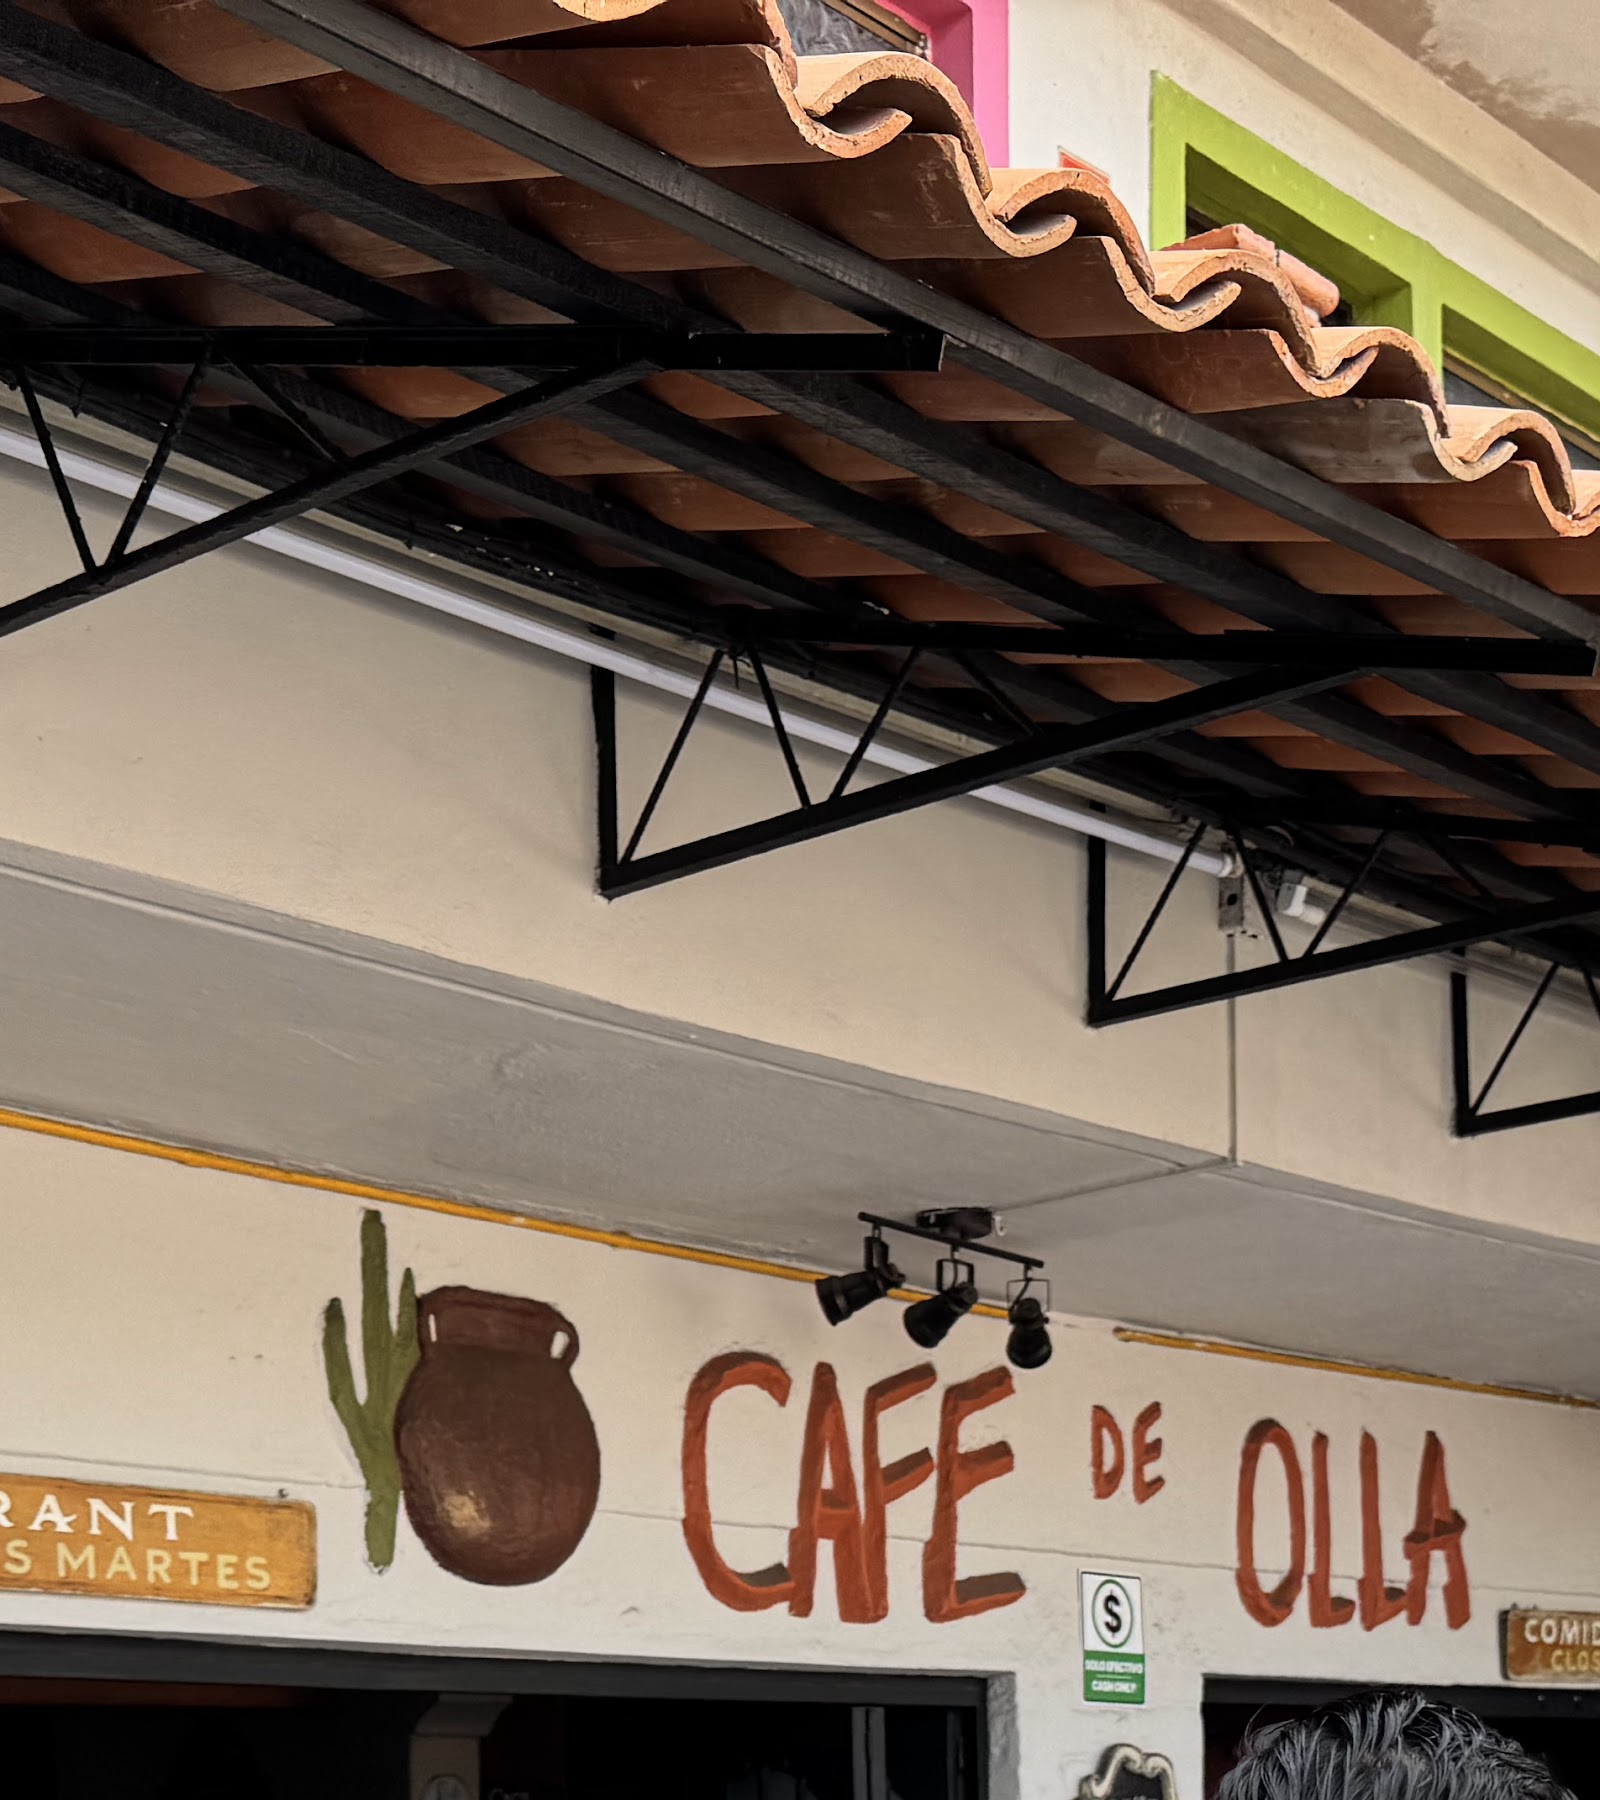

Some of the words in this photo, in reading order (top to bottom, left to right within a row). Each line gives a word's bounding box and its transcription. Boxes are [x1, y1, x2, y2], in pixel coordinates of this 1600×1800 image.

[56, 1541, 272, 1591] MARTES
[681, 1351, 1026, 1624] CAFE
[1091, 1401, 1165, 1504] DE
[1235, 1418, 1471, 1632] OLLA
